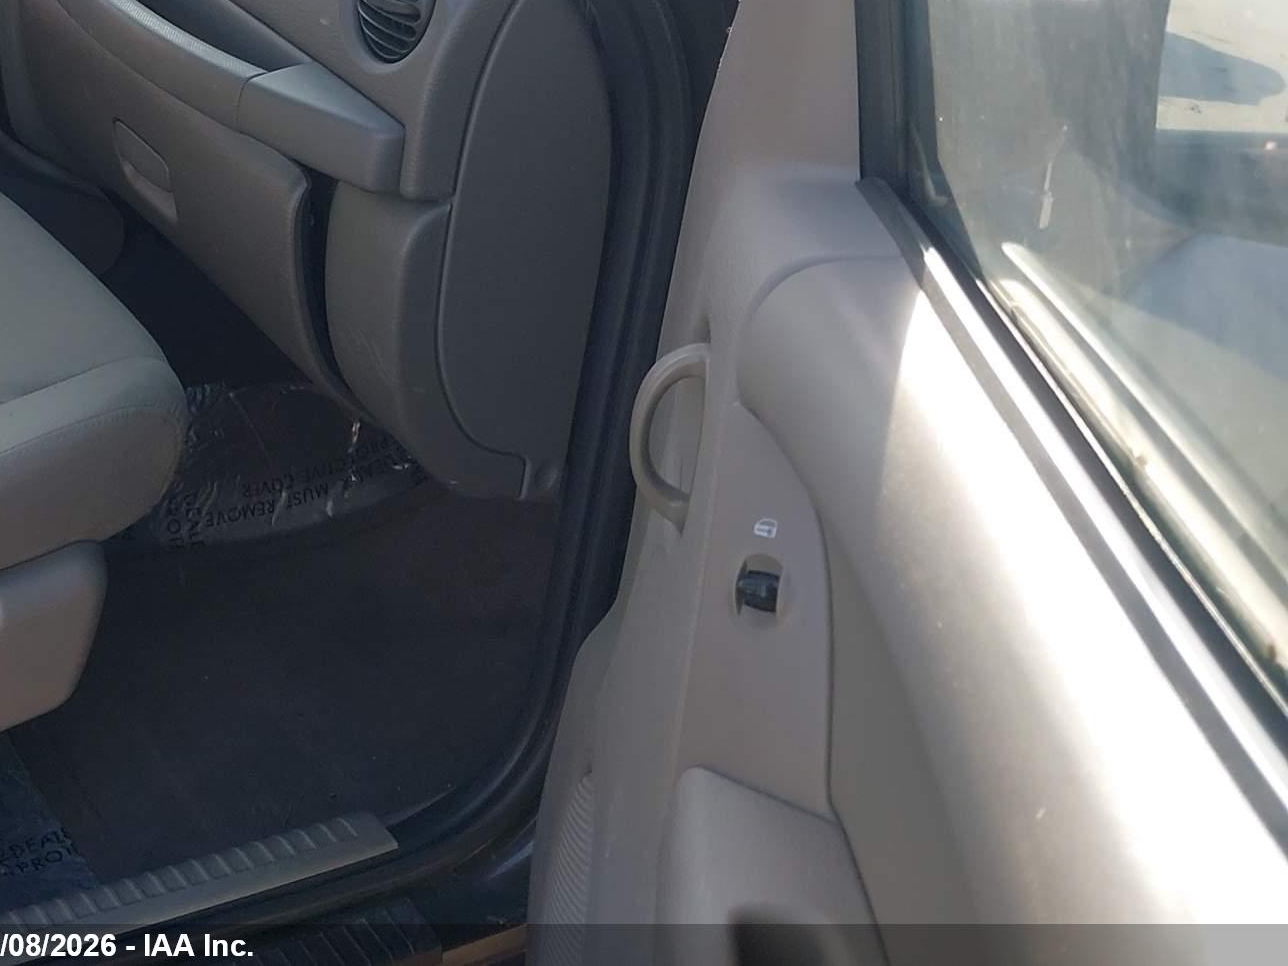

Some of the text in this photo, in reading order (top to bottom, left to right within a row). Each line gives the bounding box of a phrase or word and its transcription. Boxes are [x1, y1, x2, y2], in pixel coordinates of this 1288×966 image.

[242, 472, 295, 499] COVER
[286, 481, 329, 509] MUST
[205, 498, 276, 528] REMOVE
